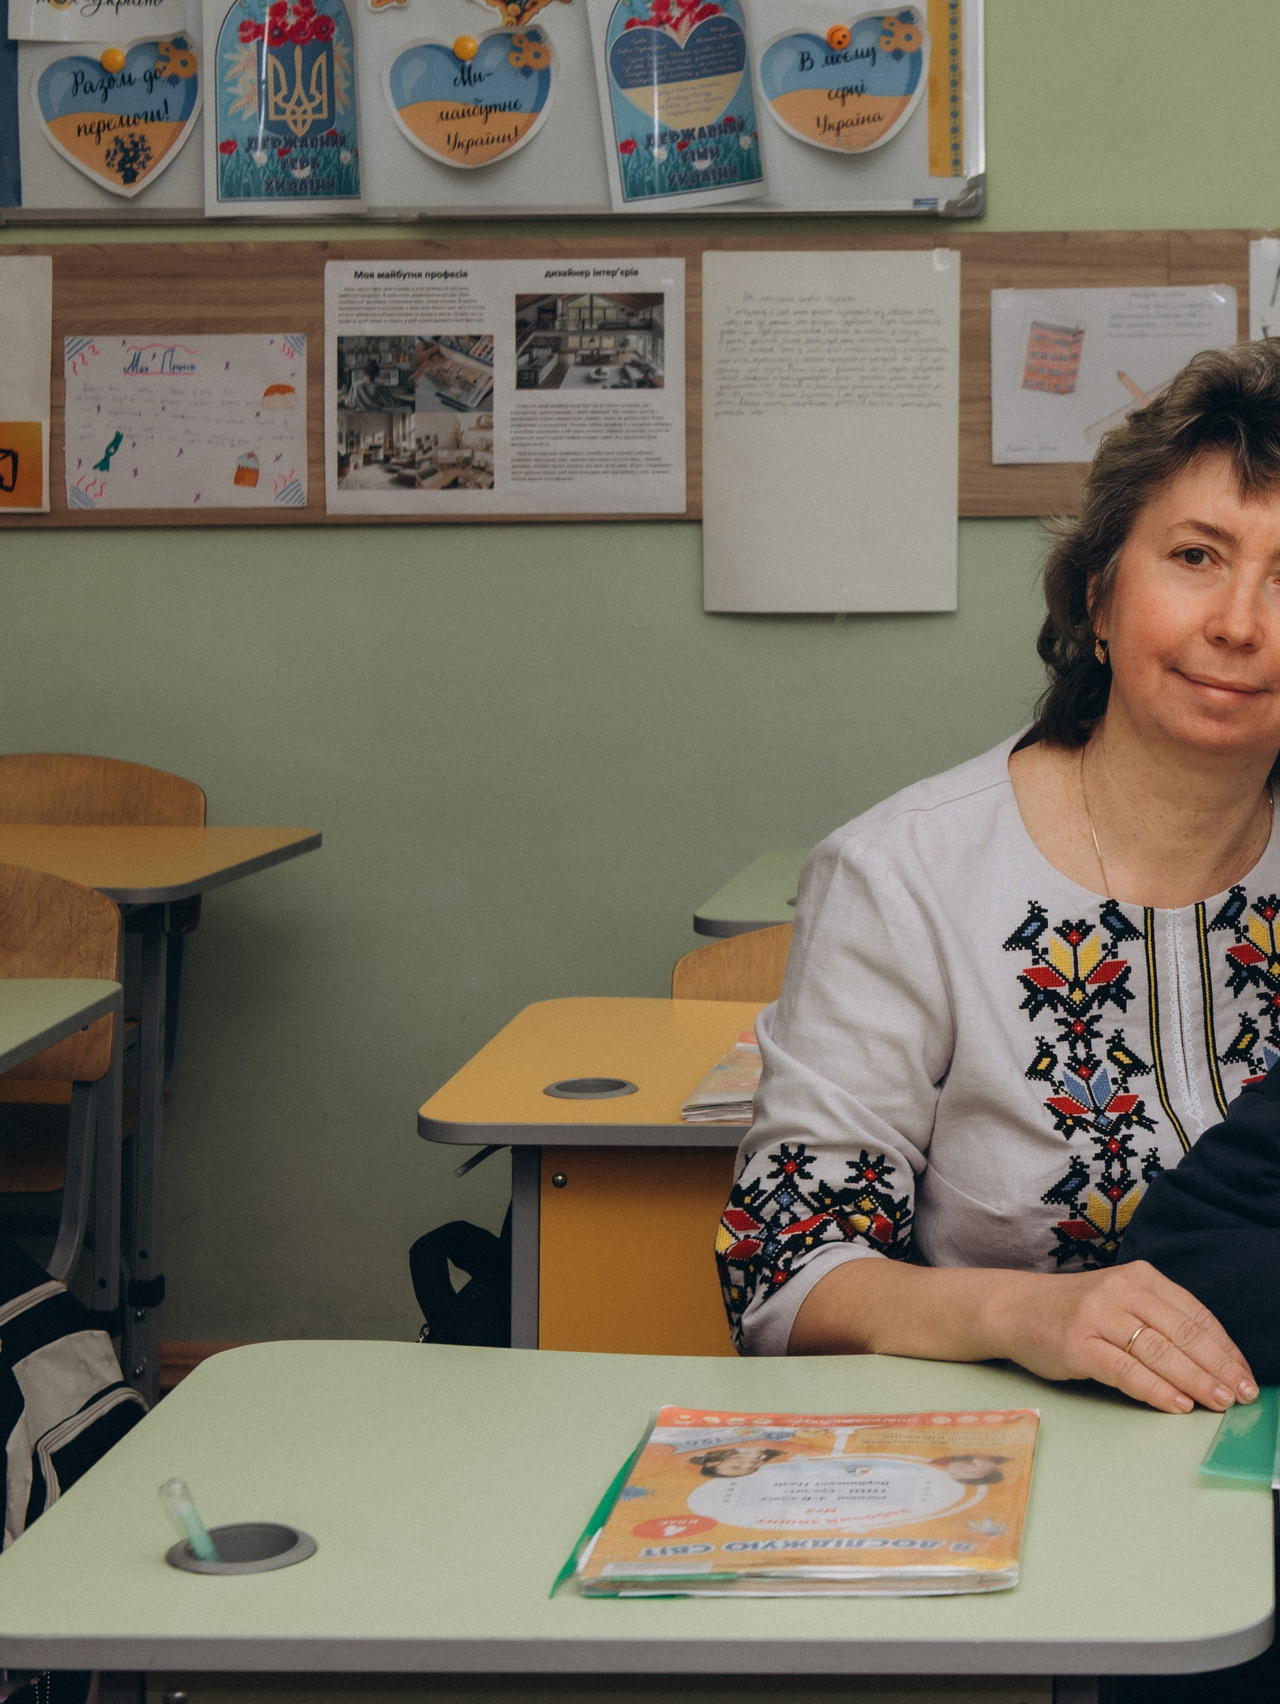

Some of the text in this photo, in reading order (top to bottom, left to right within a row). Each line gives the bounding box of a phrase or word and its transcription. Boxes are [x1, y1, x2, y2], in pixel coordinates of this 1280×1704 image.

[797, 50, 816, 73] В
[72, 68, 165, 104] Разом до
[827, 79, 870, 108] серці
[77, 98, 171, 146] перемоги!
[435, 97, 525, 125] майбутнє
[644, 116, 746, 150] ДЕРЖАВНИЙ
[815, 111, 886, 139] Україна
[245, 131, 348, 153] ДЕРЖАВНИЙ
[446, 125, 520, 155] України!
[280, 156, 320, 170] ГЕРБ
[680, 144, 722, 164] ГІМН
[354, 269, 469, 282] Моя майбутня професія
[544, 268, 591, 280] дизайнер
[662, 1525, 688, 1538] 4
[638, 1543, 715, 1558] СВІТ
[720, 1538, 945, 1554] ДОСЛІДЖУЮ
